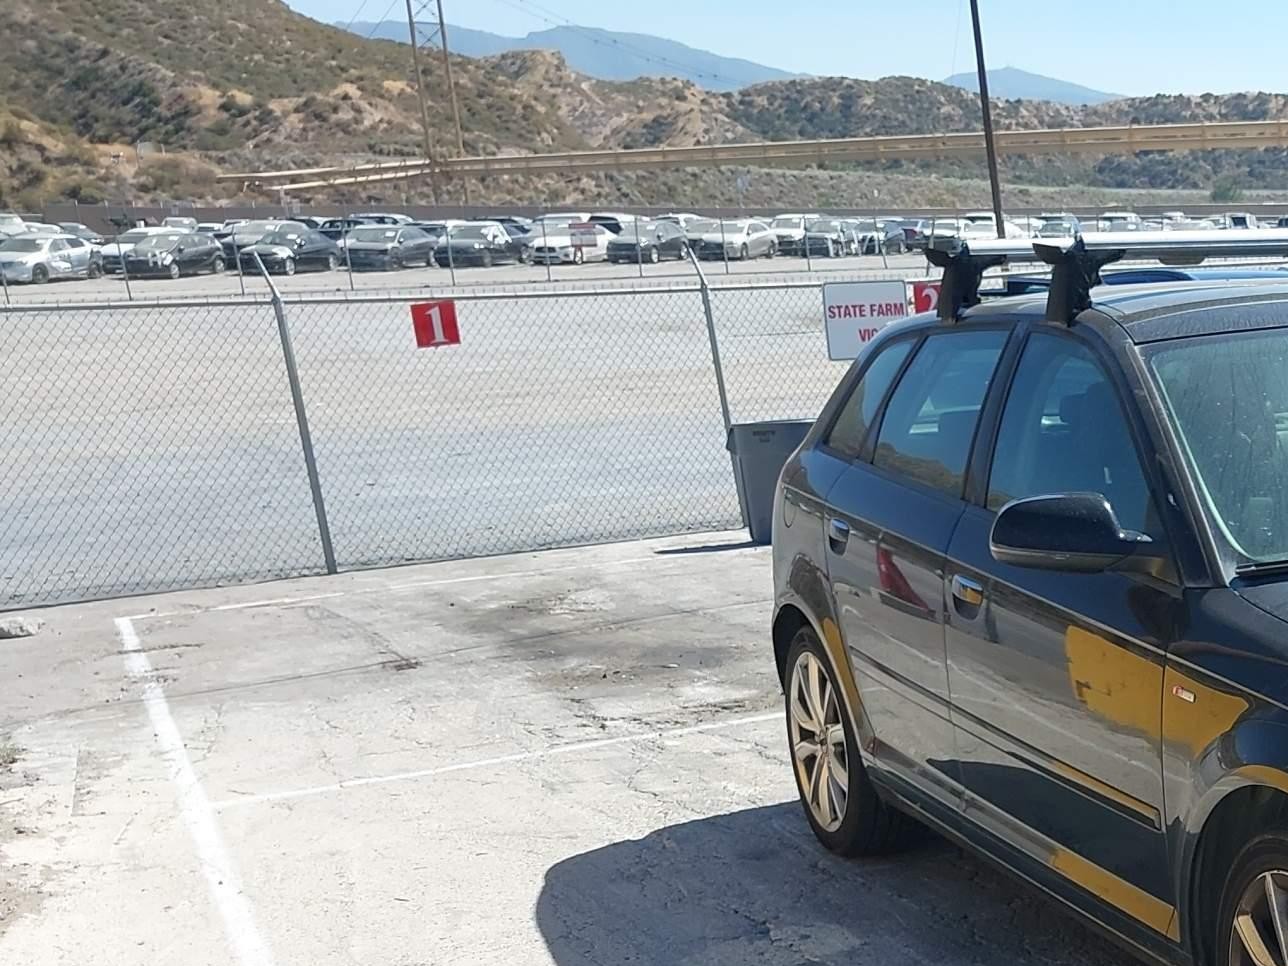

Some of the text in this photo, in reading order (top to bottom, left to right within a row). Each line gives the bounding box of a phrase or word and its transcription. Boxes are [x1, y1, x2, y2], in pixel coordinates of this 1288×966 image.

[424, 305, 449, 343] 1
[827, 302, 905, 319] STATE FARM
